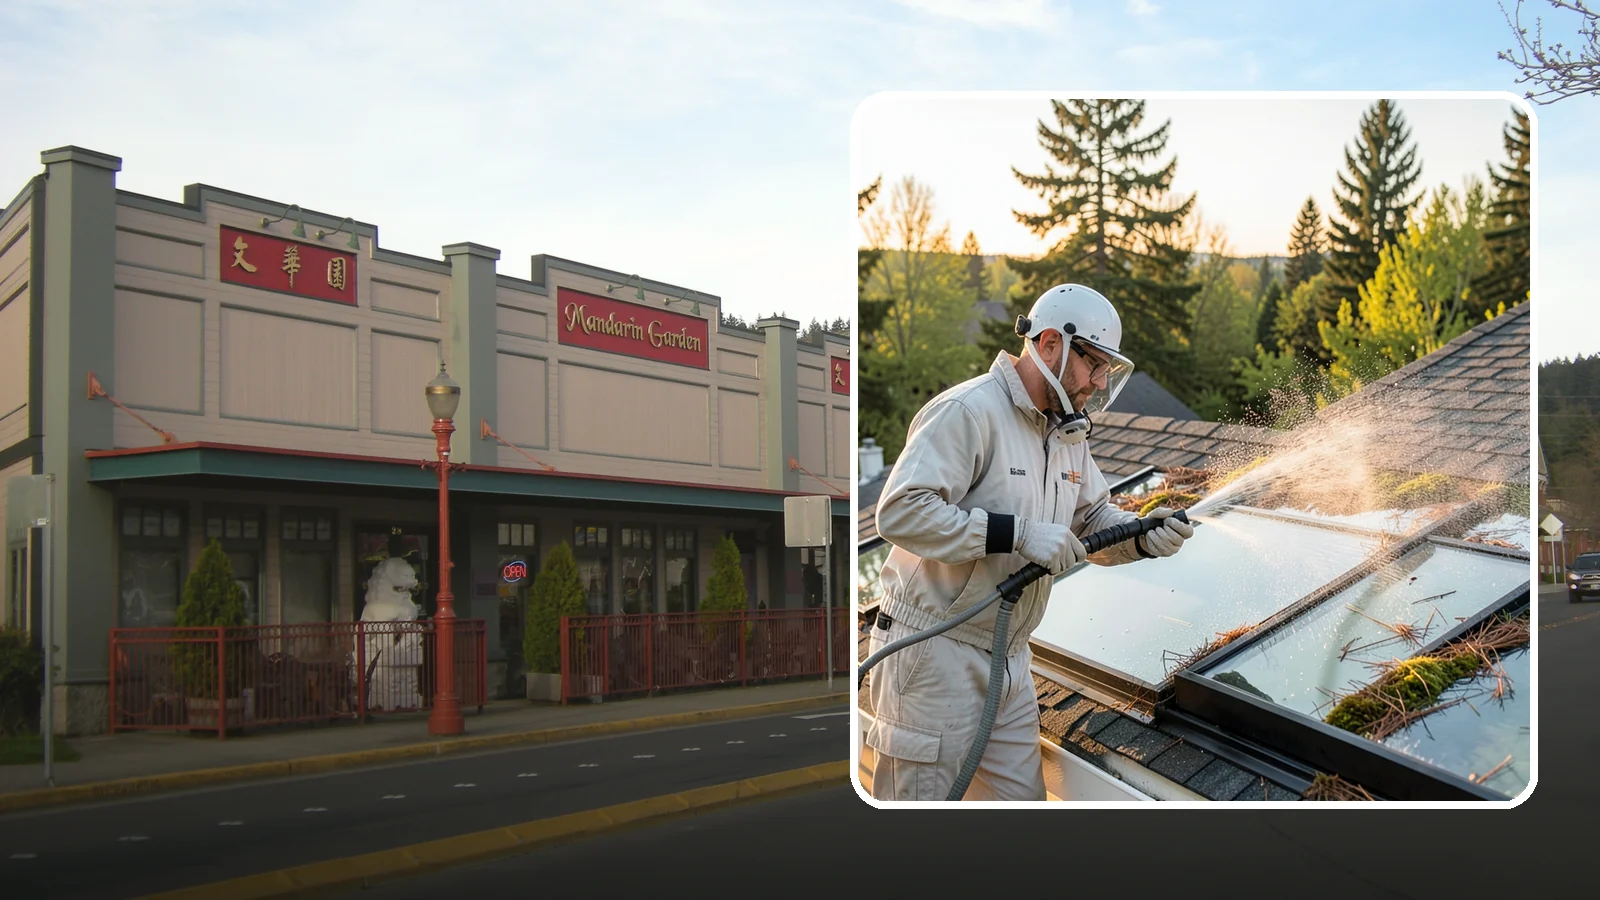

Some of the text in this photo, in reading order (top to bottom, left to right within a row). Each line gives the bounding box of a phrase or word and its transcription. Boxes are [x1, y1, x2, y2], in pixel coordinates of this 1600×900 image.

[564, 302, 701, 352] Mandarin Garden
[503, 565, 526, 578] OPEN
